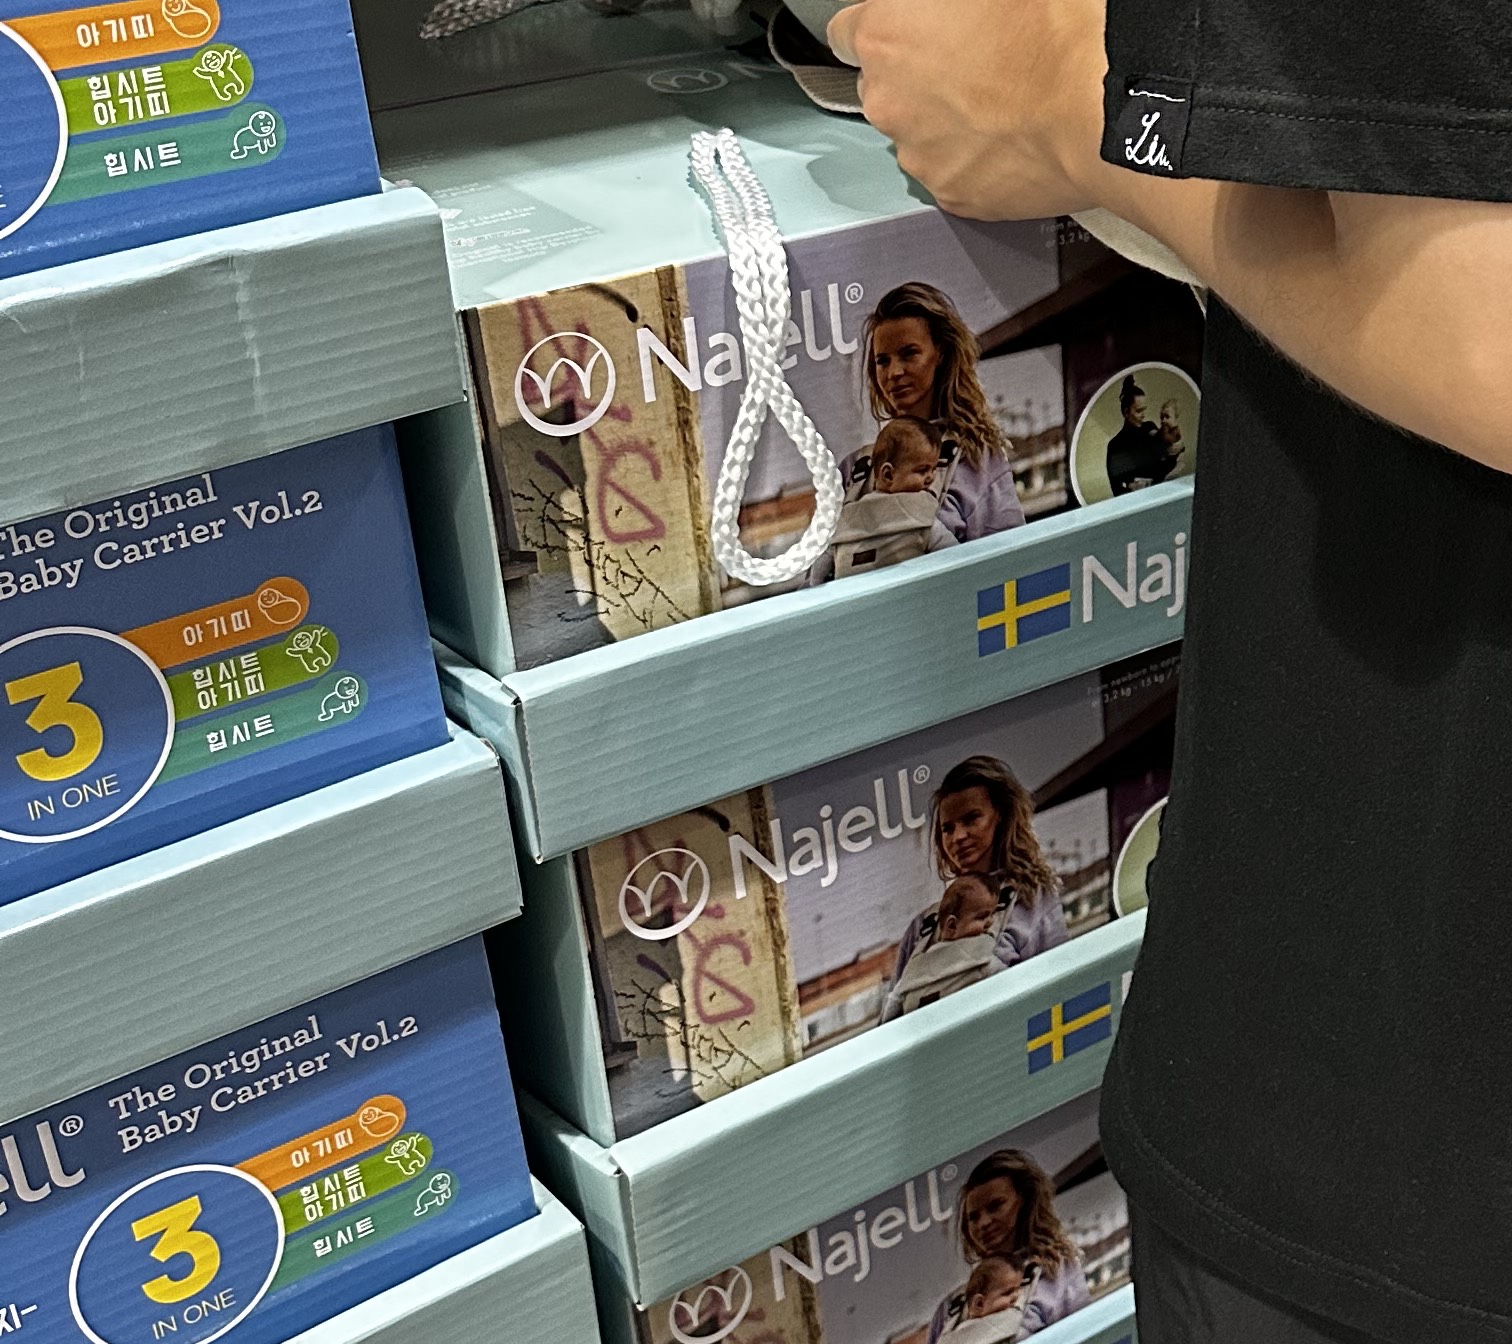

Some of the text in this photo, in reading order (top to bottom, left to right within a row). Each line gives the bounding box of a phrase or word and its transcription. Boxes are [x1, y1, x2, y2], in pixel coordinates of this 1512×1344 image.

[63, 472, 219, 539] Original
[93, 517, 227, 571] Carrier
[232, 489, 324, 530] Vol.2
[4, 660, 105, 783] 3
[27, 773, 121, 822] IN ONE
[107, 1014, 324, 1122] The Original
[117, 1014, 420, 1155] Baby Carrier Vol.2
[130, 1194, 222, 1305] 3
[152, 1287, 238, 1341] IN ONE
